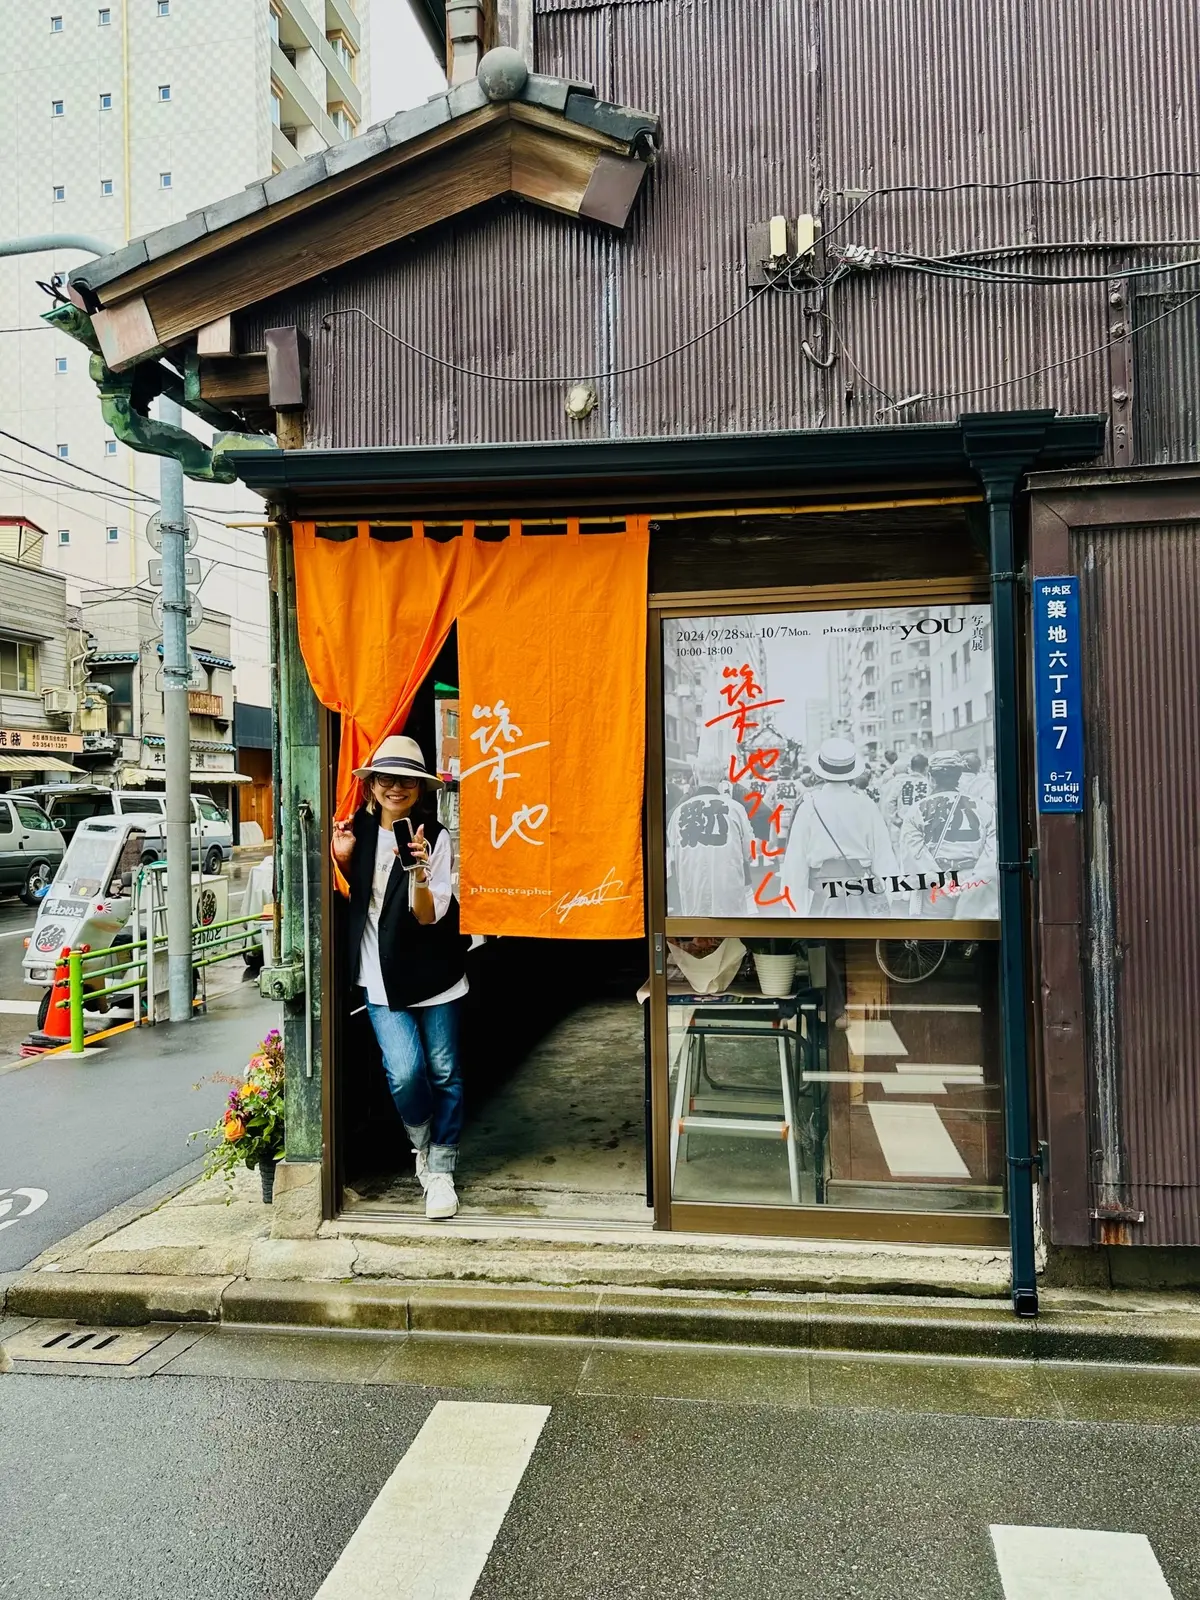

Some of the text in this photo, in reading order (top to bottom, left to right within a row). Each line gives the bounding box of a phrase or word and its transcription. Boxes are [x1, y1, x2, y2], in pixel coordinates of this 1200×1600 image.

[1041, 584, 1072, 596] 中央区
[822, 623, 897, 635] photographer
[971, 614, 984, 652] 写真展
[676, 646, 733, 657] 10:00-18:00
[1043, 782, 1079, 795] Tsukiji
[1043, 793, 1079, 805] Chuo City
[821, 870, 961, 899] TSUKIJI
[469, 886, 553, 897] photographer
